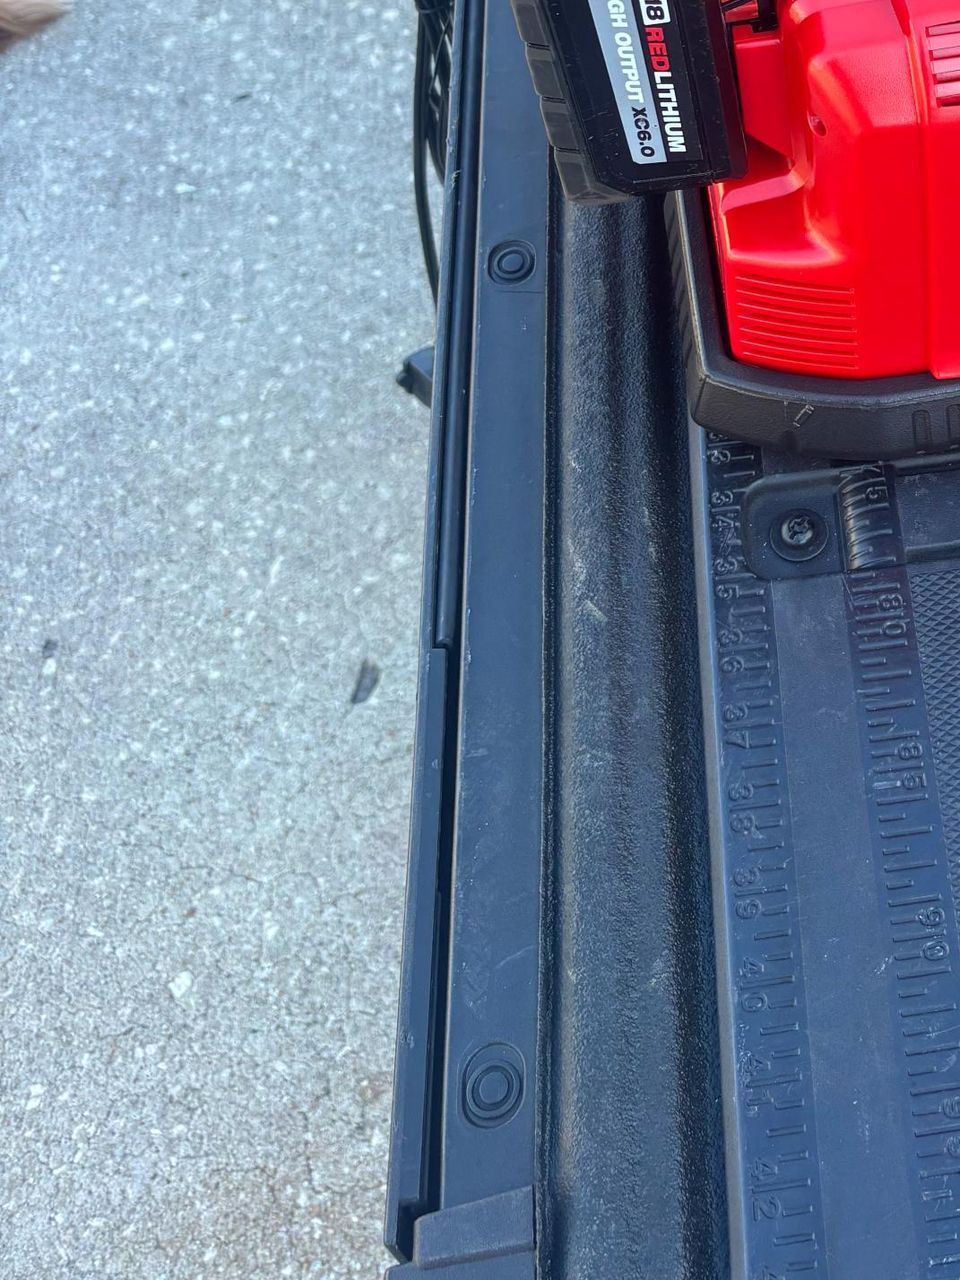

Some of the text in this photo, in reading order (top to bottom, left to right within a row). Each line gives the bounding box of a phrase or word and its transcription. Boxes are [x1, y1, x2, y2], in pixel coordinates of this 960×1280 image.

[615, 32, 645, 104] OUTPUT
[632, 107, 656, 158] XC6.0
[644, 27, 686, 153] REDLITHIUM
